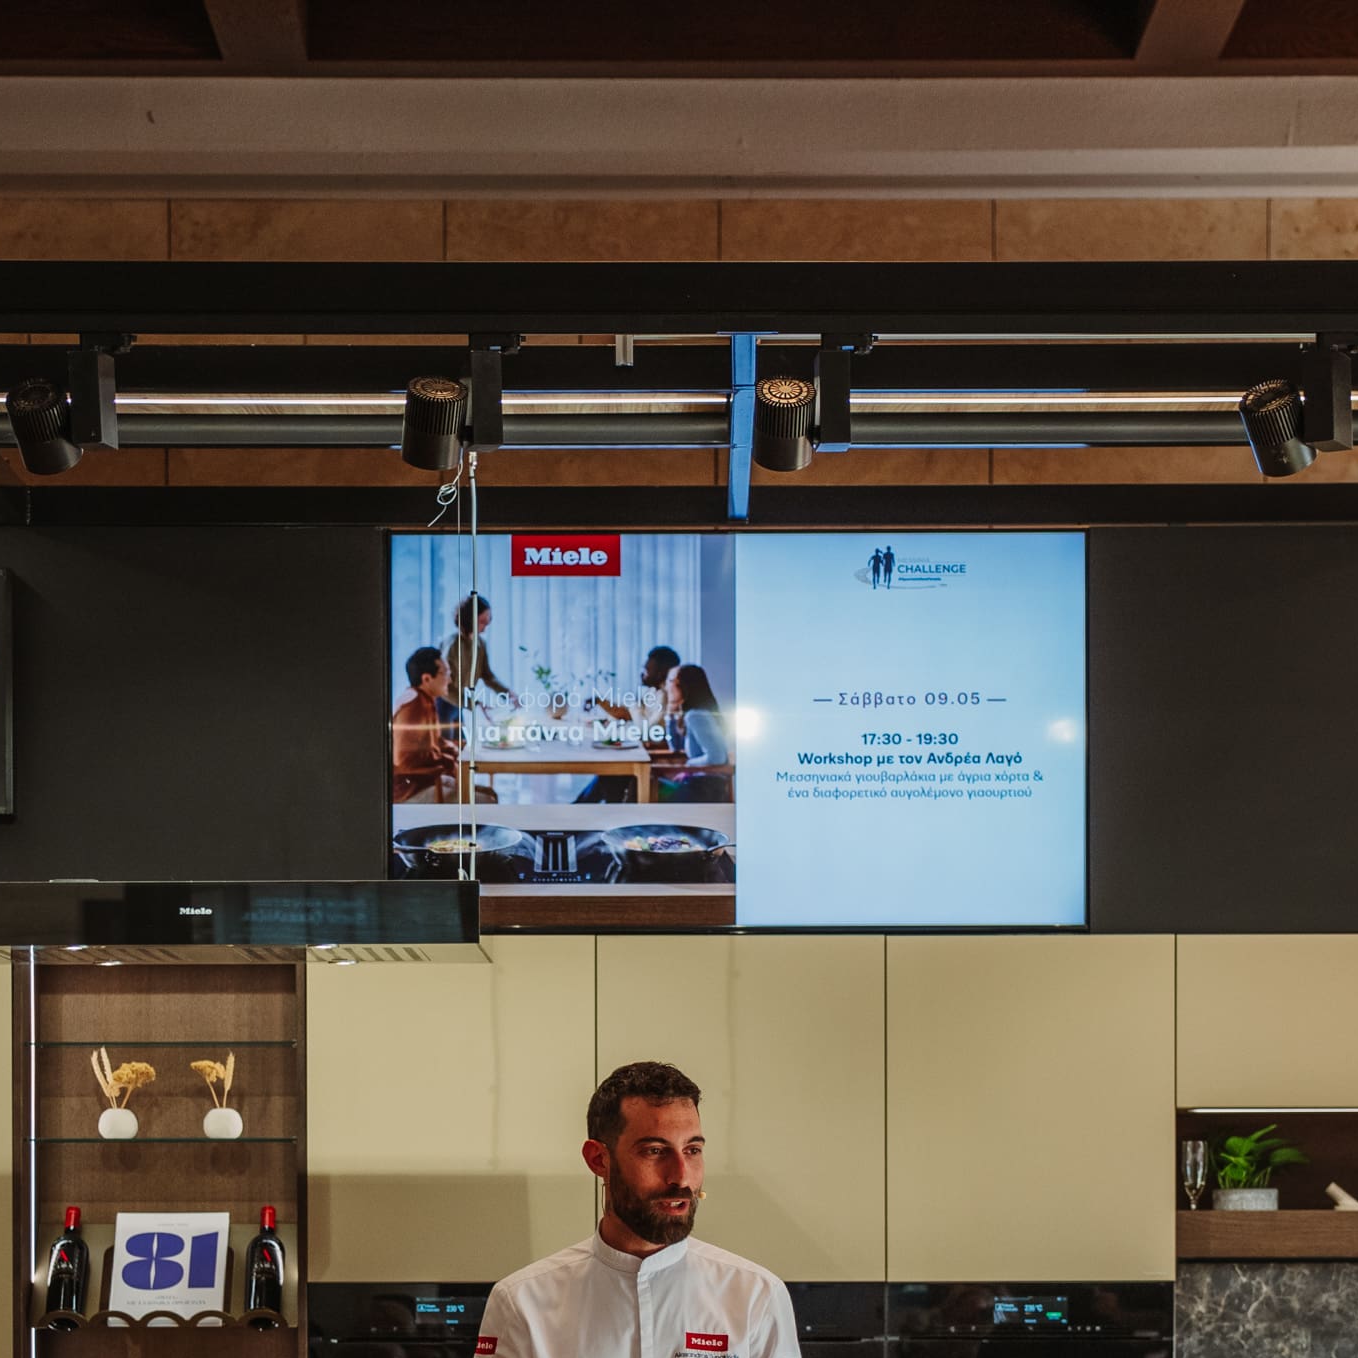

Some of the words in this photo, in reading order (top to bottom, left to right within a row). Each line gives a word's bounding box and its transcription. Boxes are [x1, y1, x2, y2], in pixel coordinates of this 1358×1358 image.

[524, 547, 608, 566] Miele
[897, 564, 966, 574] CHALLENGE
[838, 692, 917, 709] Σάββατο
[924, 692, 981, 706] 09.05
[507, 720, 584, 742] πάντα
[593, 720, 672, 742] Miele.
[861, 733, 902, 746] 17:30
[916, 733, 959, 746] 19:30
[797, 752, 873, 768] Workshop
[876, 755, 895, 768] με
[898, 755, 923, 765] τον
[926, 752, 982, 768] Ανδρέα
[985, 752, 1023, 768] Λαγό
[776, 771, 852, 784] Μεσσηνιακά
[855, 771, 936, 784] γιουβαρλάκια
[939, 773, 954, 784] με
[957, 771, 992, 784] άγρια
[994, 771, 1030, 784] χόρτα
[1032, 771, 1044, 782] &
[787, 787, 809, 798] ένα
[812, 787, 888, 800] διαφορετικό
[890, 787, 964, 800] αυγολέμονο
[179, 907, 213, 915] Miele
[121, 1231, 219, 1291] 81
[690, 1337, 724, 1347] Miele
